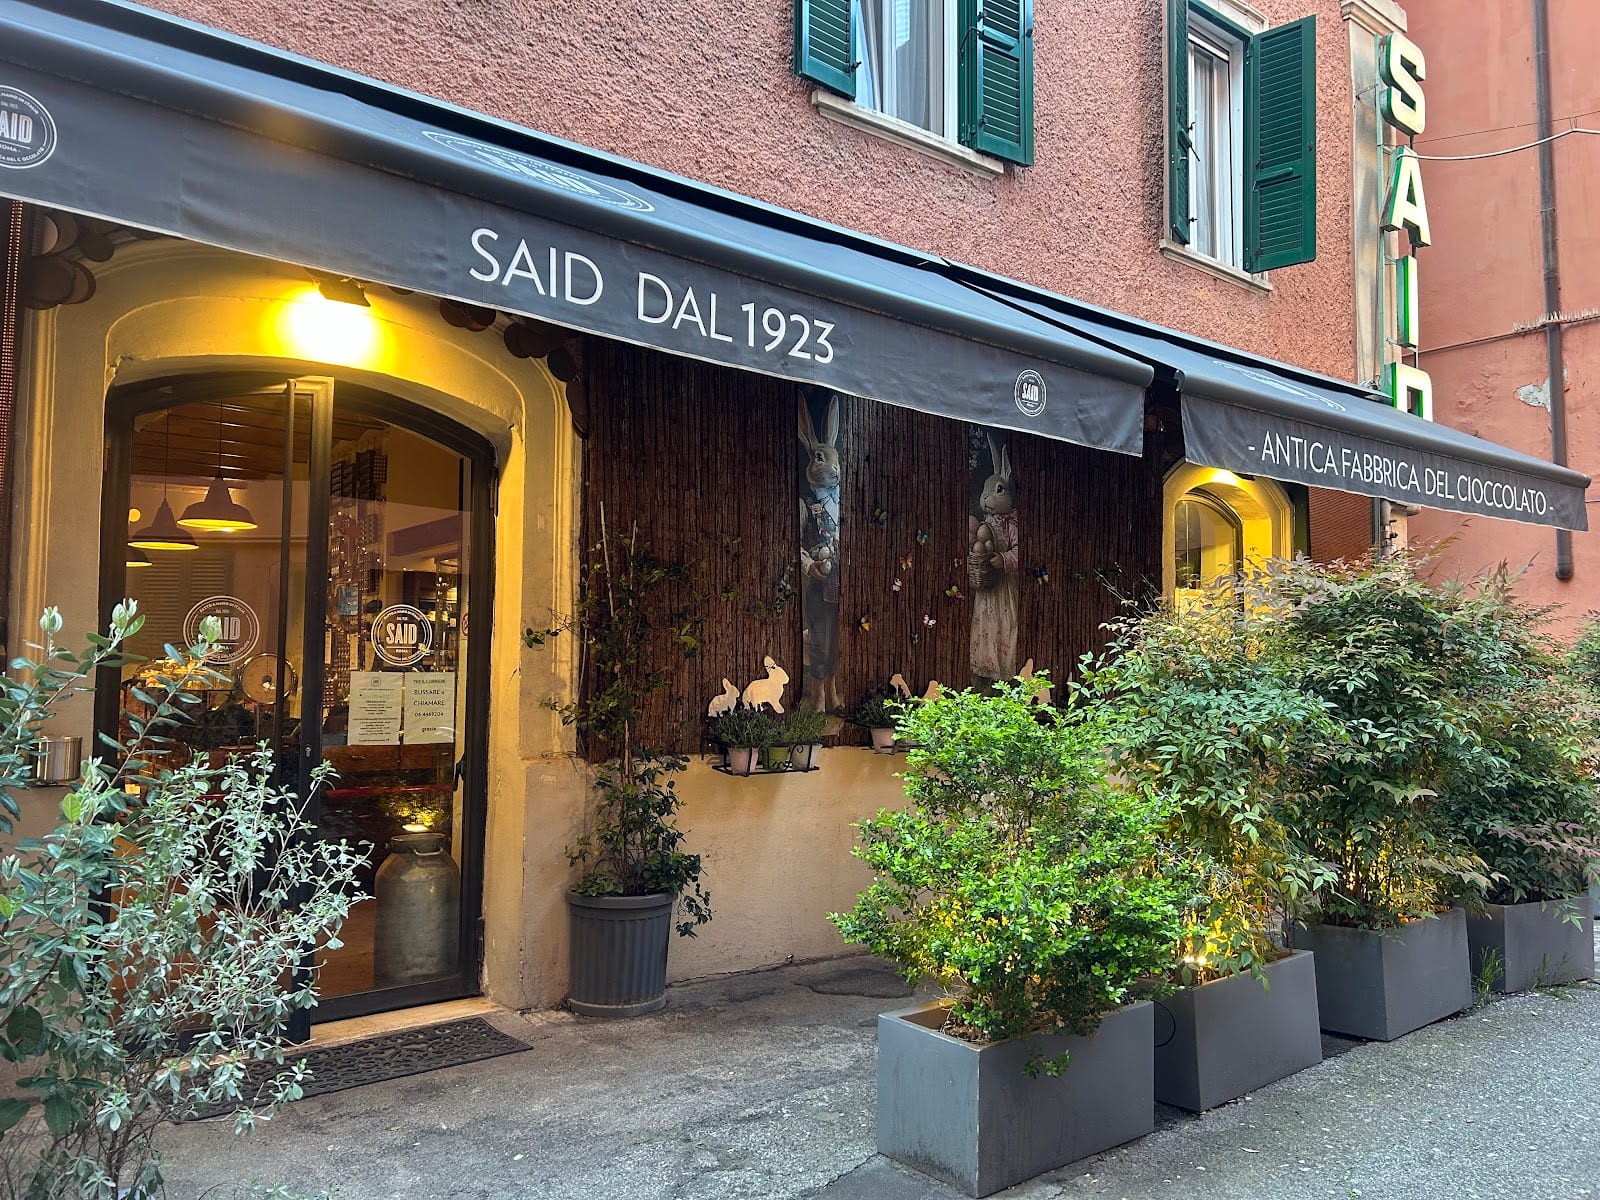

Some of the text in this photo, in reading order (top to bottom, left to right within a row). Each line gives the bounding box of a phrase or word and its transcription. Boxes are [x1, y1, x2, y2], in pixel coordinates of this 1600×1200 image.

[0, 110, 33, 143] AID
[468, 227, 836, 365] SAID DAL 1923
[1021, 382, 1039, 402] SAID
[1261, 430, 1339, 476] ANTICA
[1341, 448, 1421, 493] FABBRICA
[1424, 467, 1455, 500] DEL
[1457, 474, 1547, 515] CIOCCOLATO
[385, 622, 418, 645] SAID
